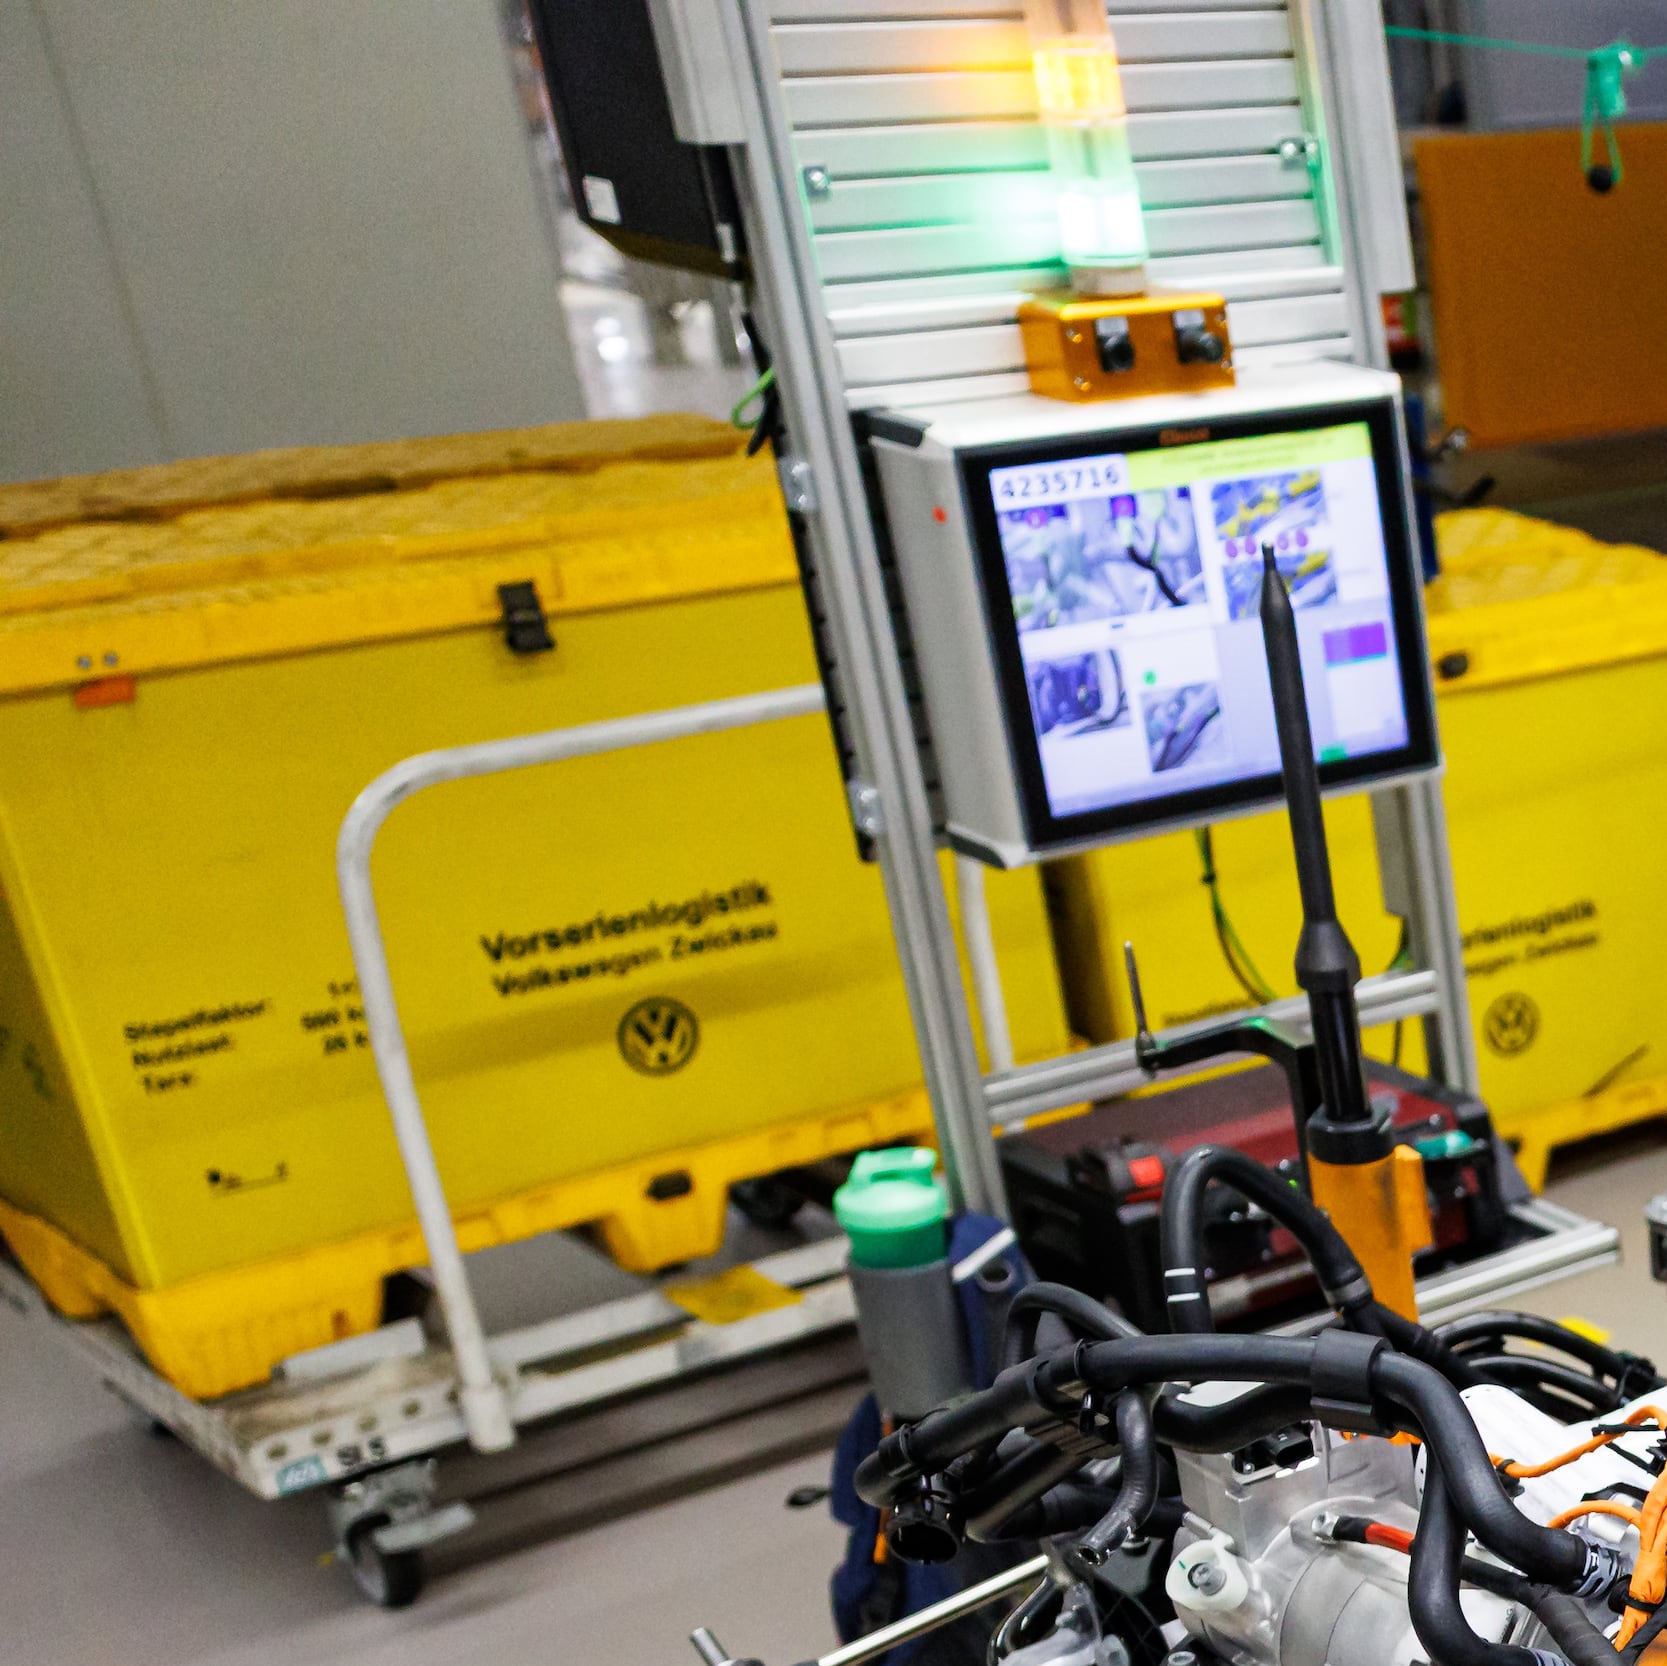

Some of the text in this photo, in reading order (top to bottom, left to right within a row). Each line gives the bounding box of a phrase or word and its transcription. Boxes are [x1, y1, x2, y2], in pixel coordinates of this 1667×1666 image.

[1001, 464, 1121, 497] 4235716
[480, 879, 773, 962] Vorserienlogistik
[493, 923, 777, 998] Volkswagen Zwickau
